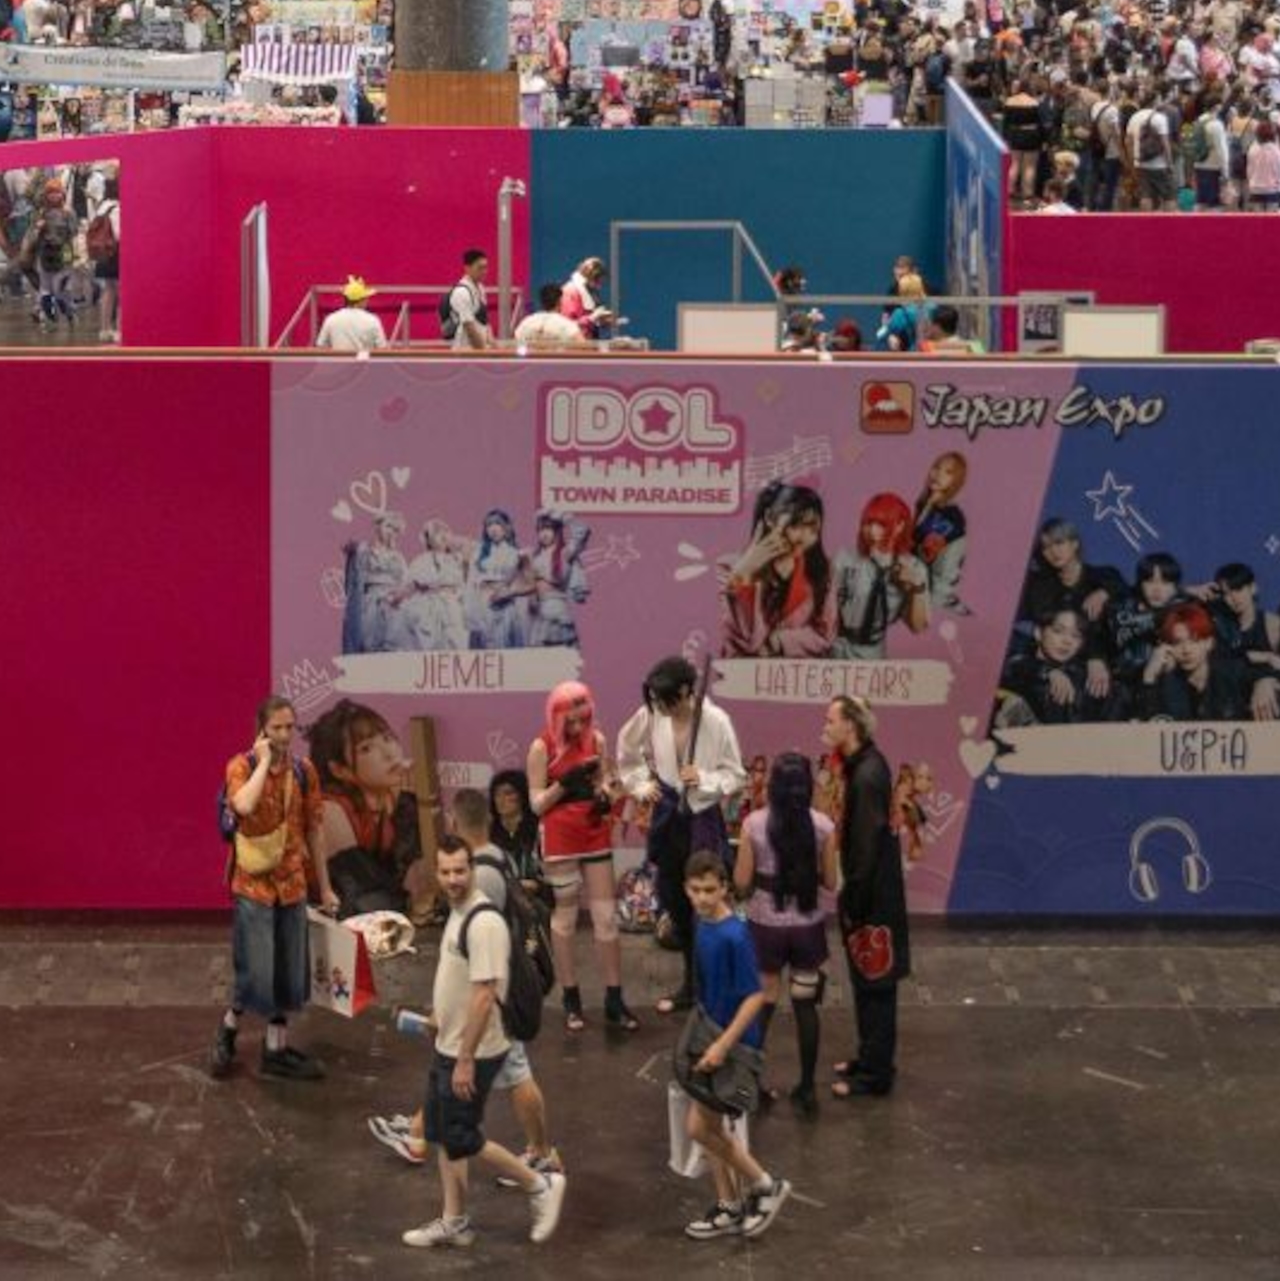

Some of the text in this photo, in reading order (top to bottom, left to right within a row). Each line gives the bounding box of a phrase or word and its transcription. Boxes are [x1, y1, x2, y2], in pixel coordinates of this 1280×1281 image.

[547, 387, 736, 452] IDOL
[922, 384, 1165, 440] Japan Expo
[549, 486, 733, 504] TOWN PARADISE
[414, 652, 505, 690] JIEMEI
